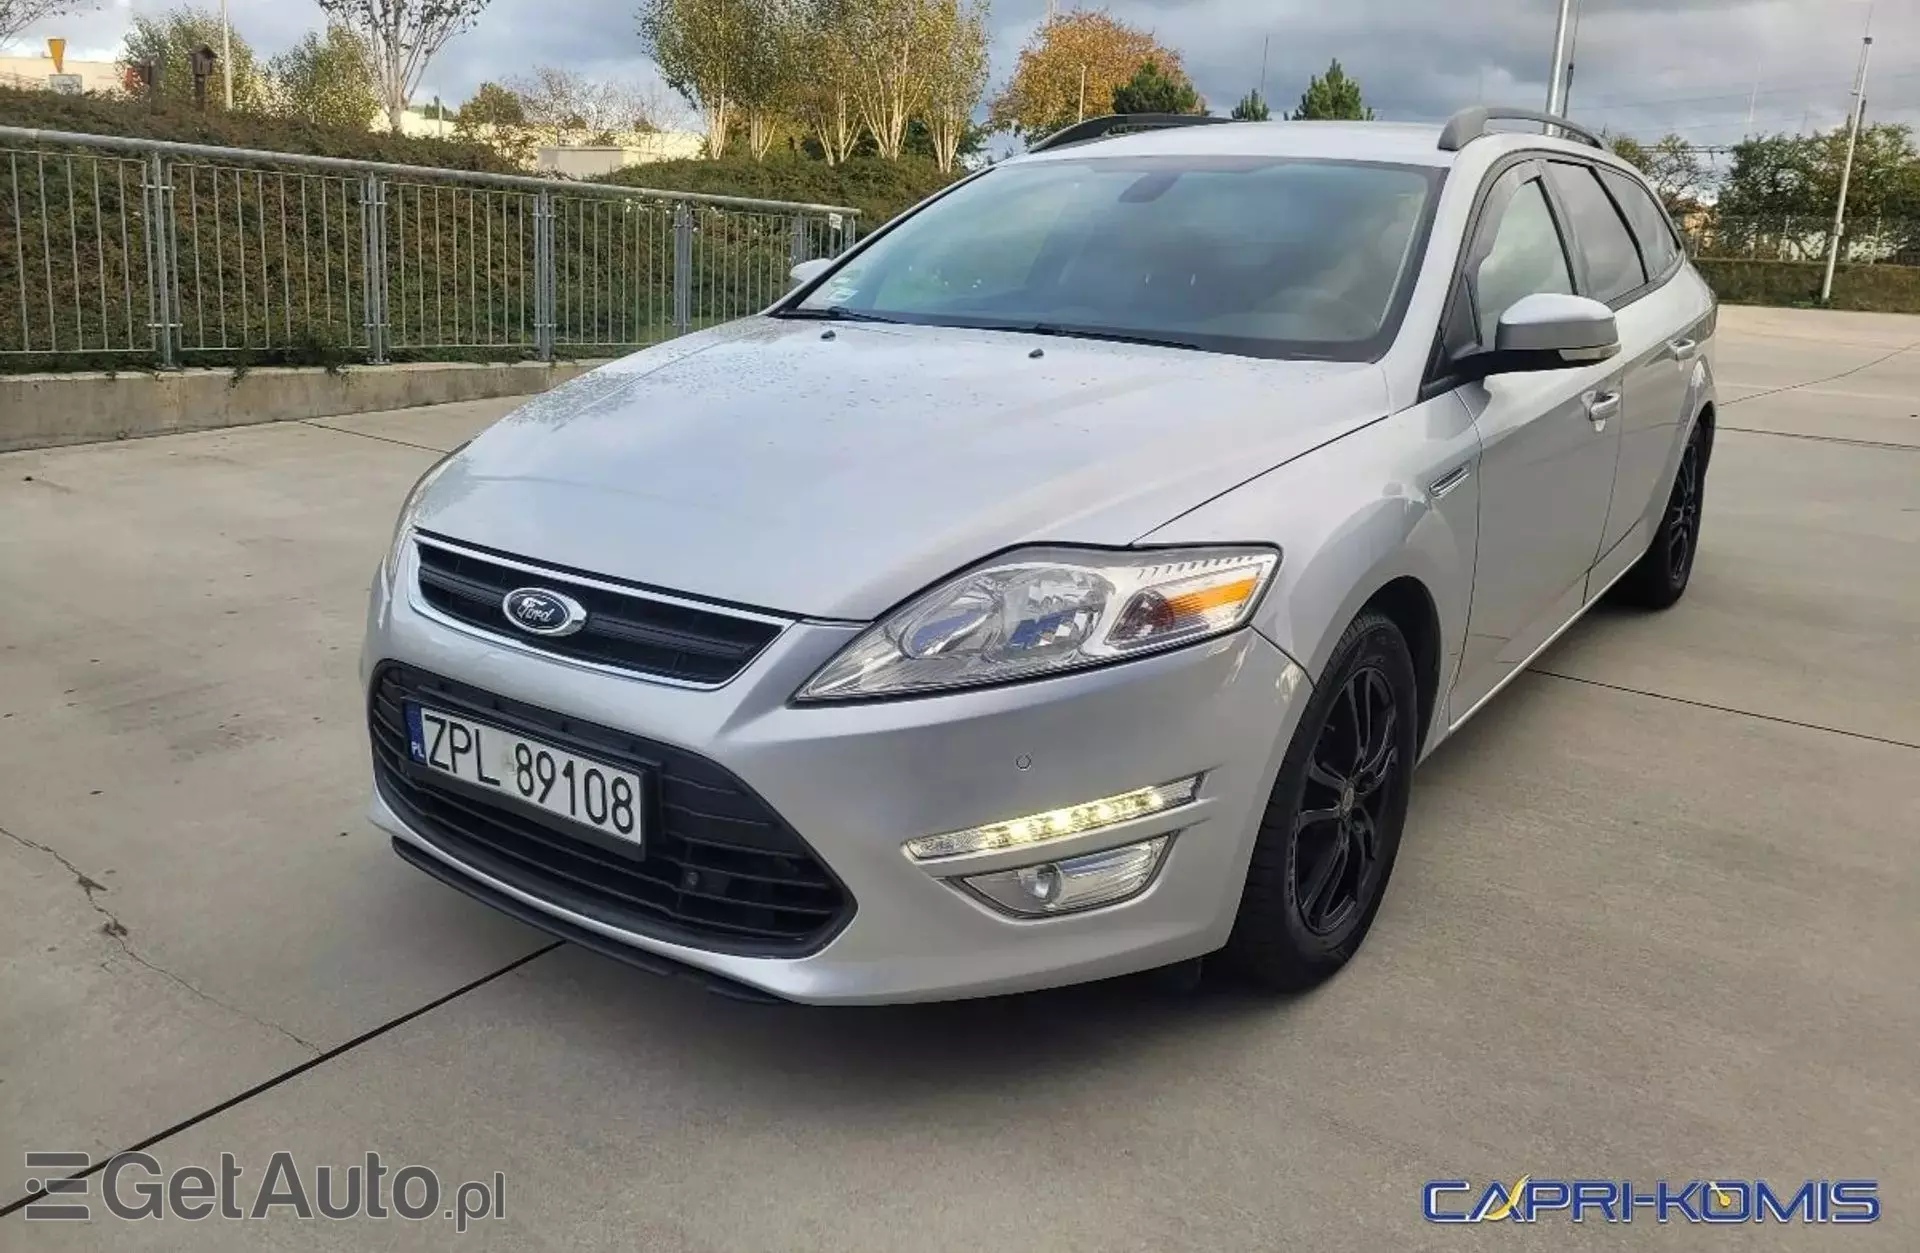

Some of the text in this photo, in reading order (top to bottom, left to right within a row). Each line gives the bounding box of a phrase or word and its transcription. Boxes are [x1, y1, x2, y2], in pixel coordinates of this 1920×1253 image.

[517, 597, 555, 622] Ford
[411, 741, 425, 758] PL
[424, 713, 634, 835] ZPL 89108
